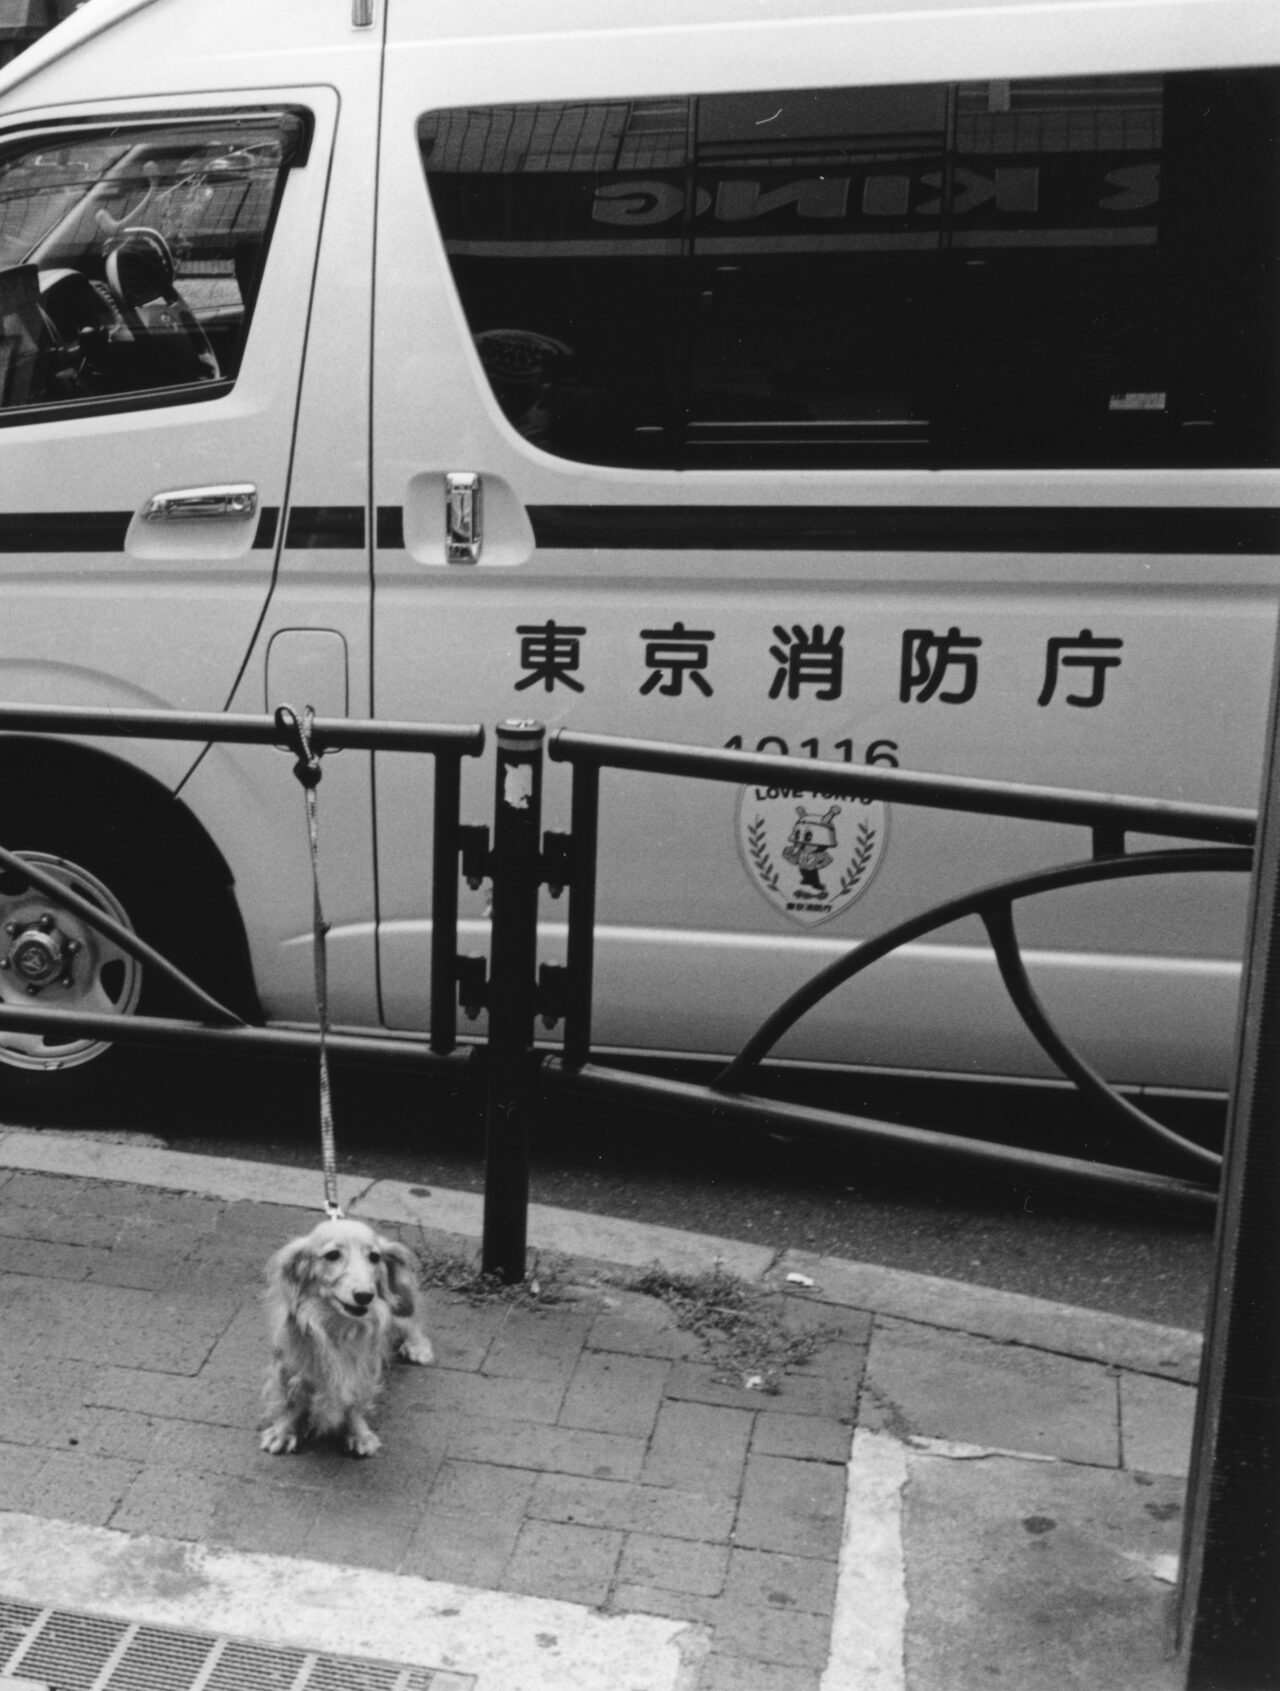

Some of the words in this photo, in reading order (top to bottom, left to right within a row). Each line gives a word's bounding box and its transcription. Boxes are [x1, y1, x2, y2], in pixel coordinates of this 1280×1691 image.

[514, 620, 1124, 707] 東京消防庁
